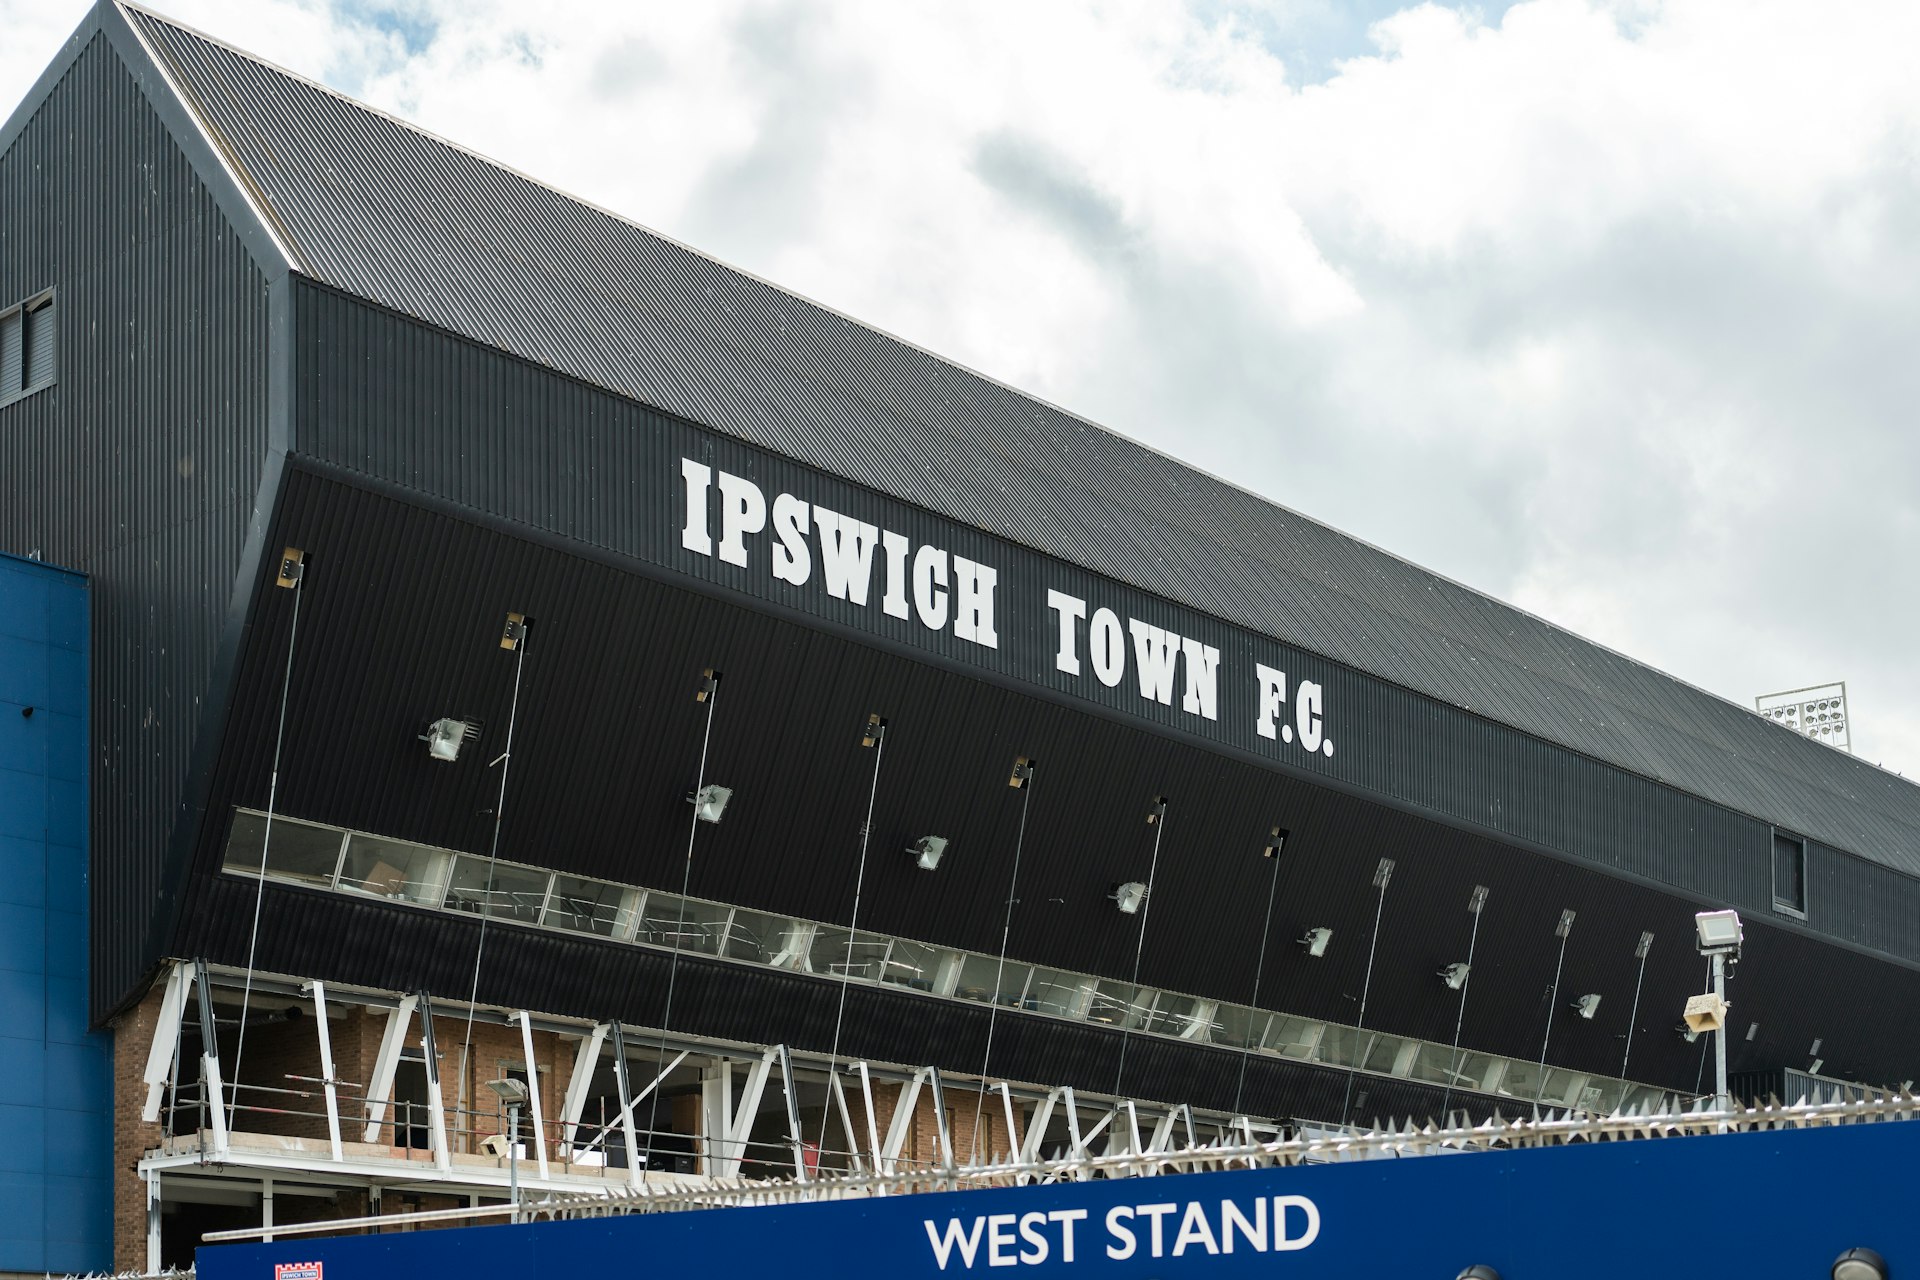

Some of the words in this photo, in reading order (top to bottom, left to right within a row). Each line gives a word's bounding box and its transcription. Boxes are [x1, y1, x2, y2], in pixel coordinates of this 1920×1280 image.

[682, 457, 997, 649] IPSWICH
[1048, 588, 1220, 721] TOWN
[1256, 662, 1334, 757] F.C.
[923, 1209, 1088, 1270] WEST
[1105, 1195, 1321, 1260] STAND
